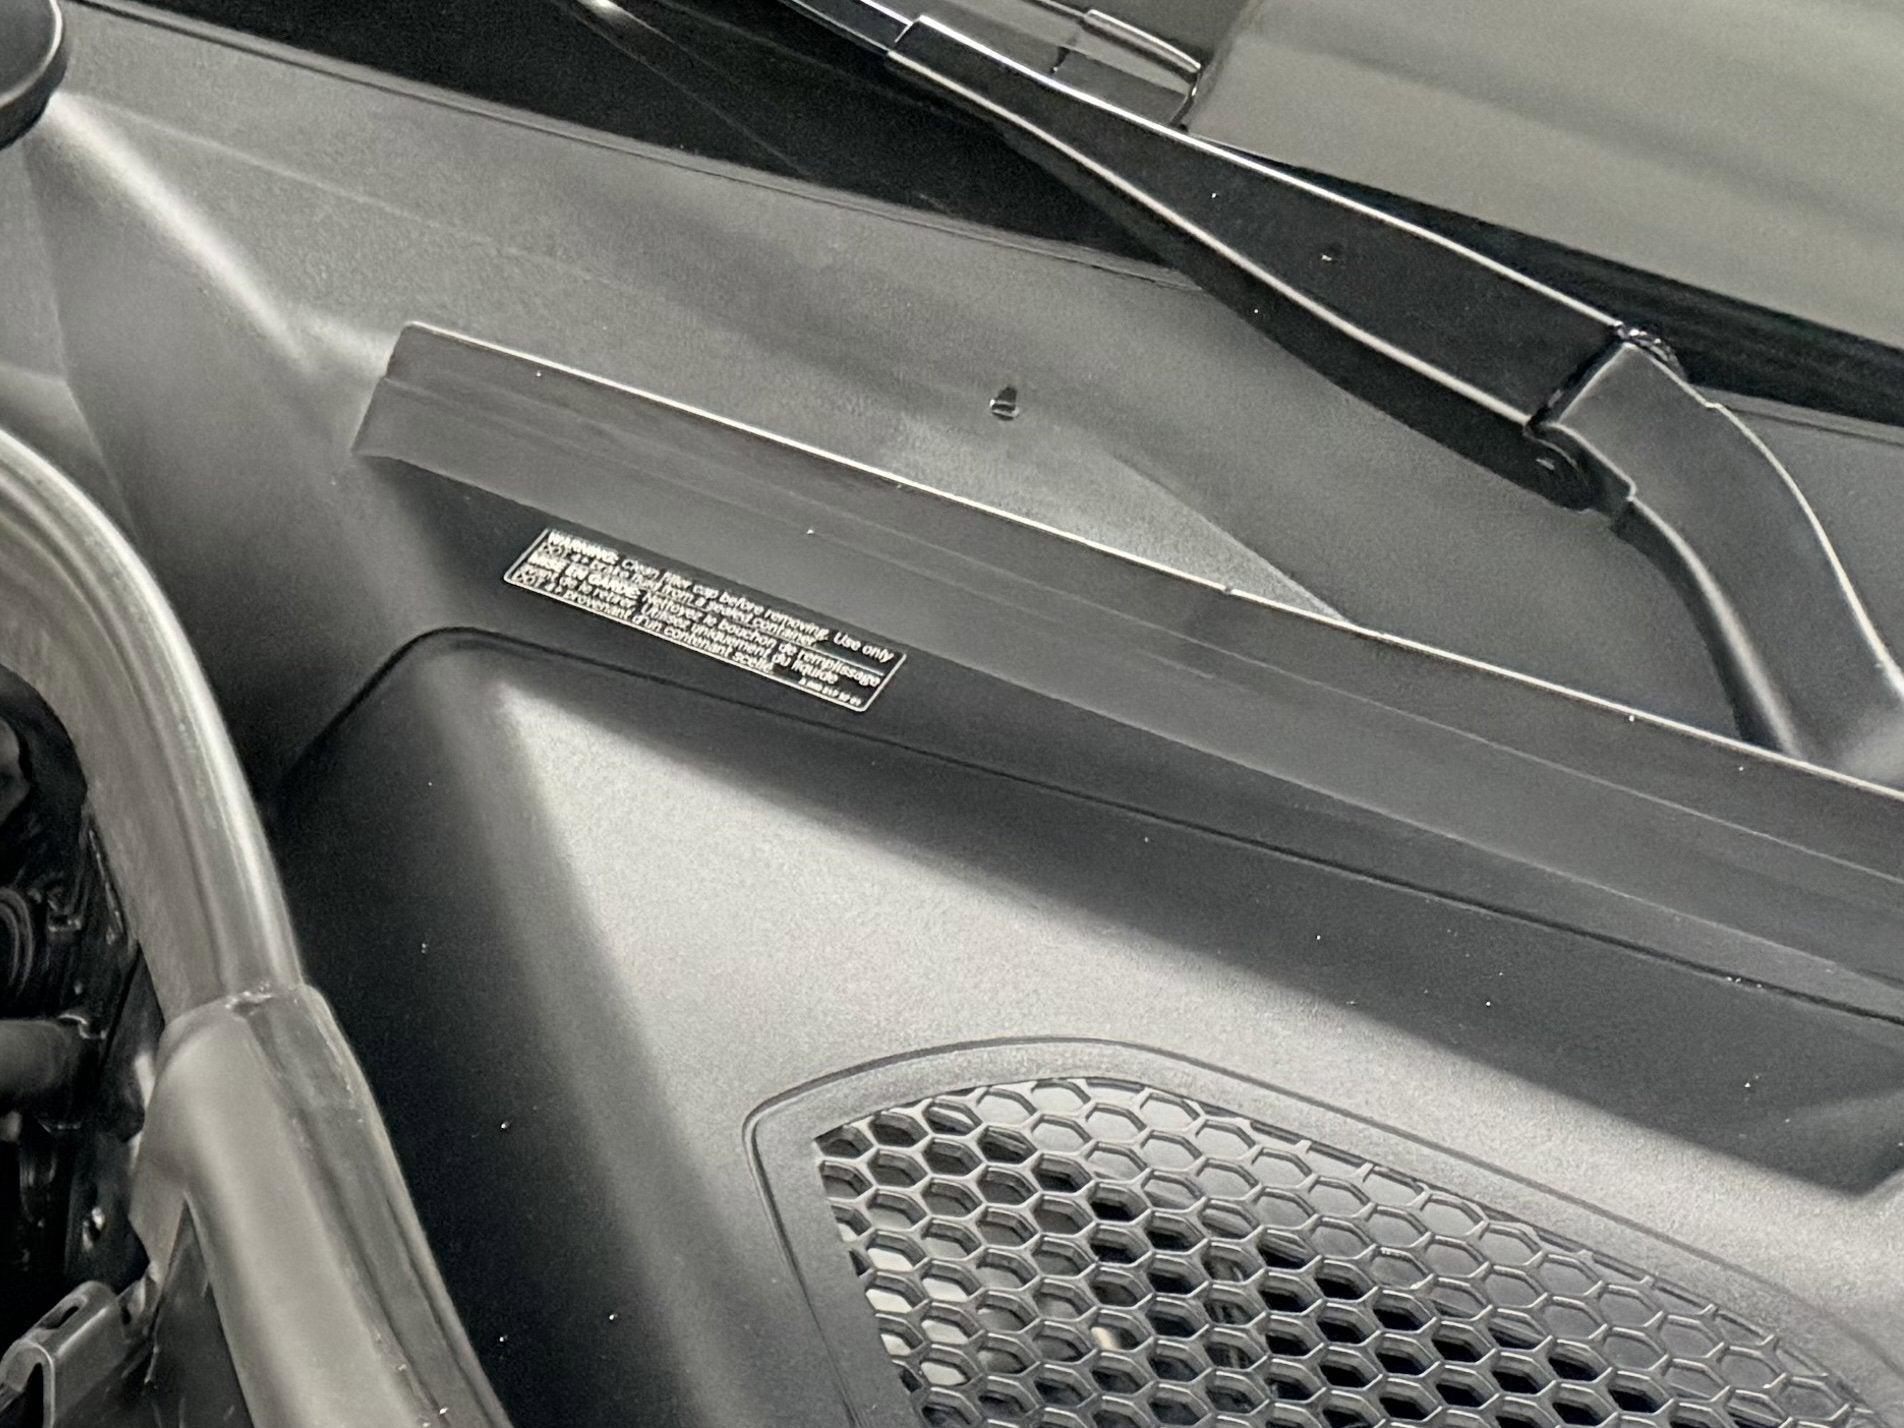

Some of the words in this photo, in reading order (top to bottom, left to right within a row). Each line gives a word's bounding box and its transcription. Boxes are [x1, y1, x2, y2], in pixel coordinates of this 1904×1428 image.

[545, 531, 621, 564] WARNING:
[619, 557, 662, 578] Clean
[689, 582, 720, 600] cap
[717, 591, 765, 615] before
[762, 607, 833, 640] removing.
[832, 632, 863, 650] Use
[860, 642, 895, 662] only
[561, 588, 632, 621] provenant
[661, 624, 732, 657] contenant
[660, 584, 695, 602] from
[705, 600, 753, 623] sealed
[751, 616, 821, 648] container.
[639, 591, 704, 622] Nettoyez
[715, 619, 778, 649] bouchon
[776, 641, 798, 657] de
[794, 648, 882, 688] remplissage
[688, 623, 770, 660] uniquement
[769, 652, 792, 667] du
[789, 660, 840, 685] liquide
